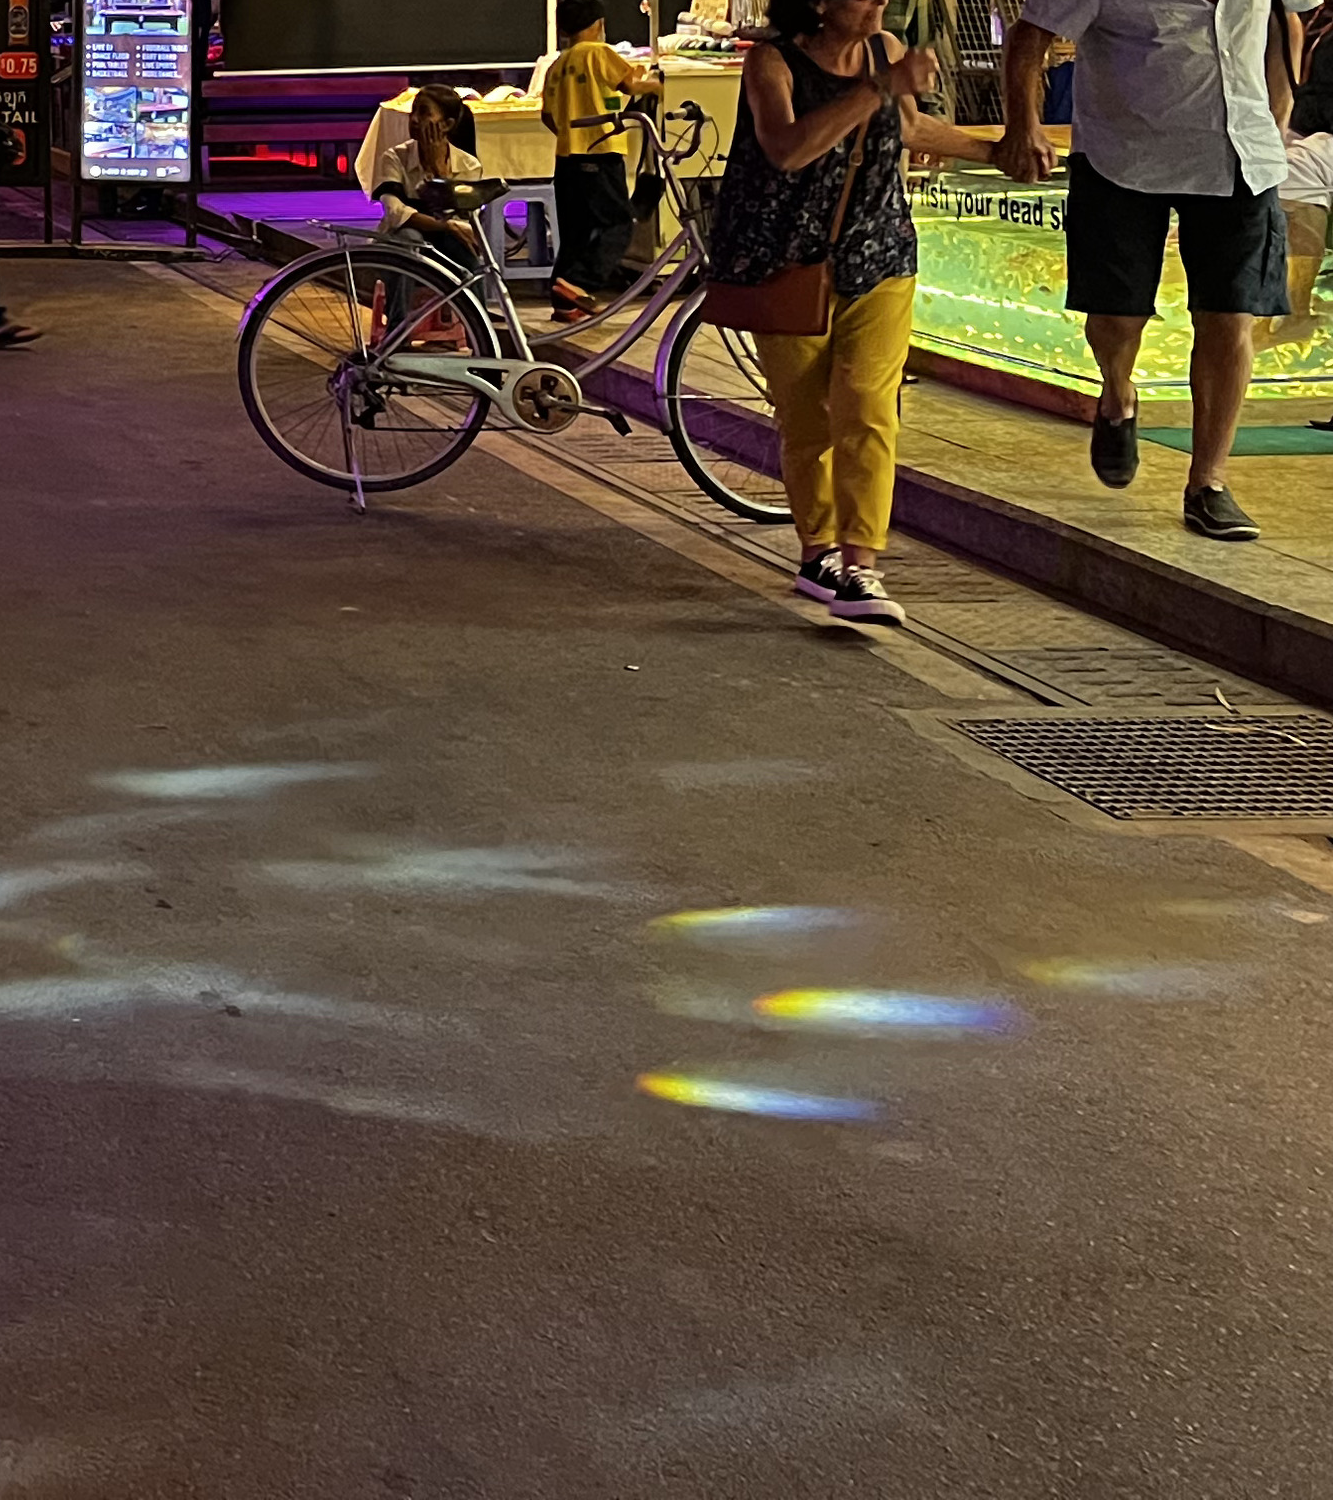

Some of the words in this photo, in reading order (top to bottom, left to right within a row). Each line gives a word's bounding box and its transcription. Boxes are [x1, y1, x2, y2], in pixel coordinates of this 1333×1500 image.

[1, 57, 38, 74] $0.75
[955, 190, 994, 221] your
[999, 195, 1044, 227] dead
